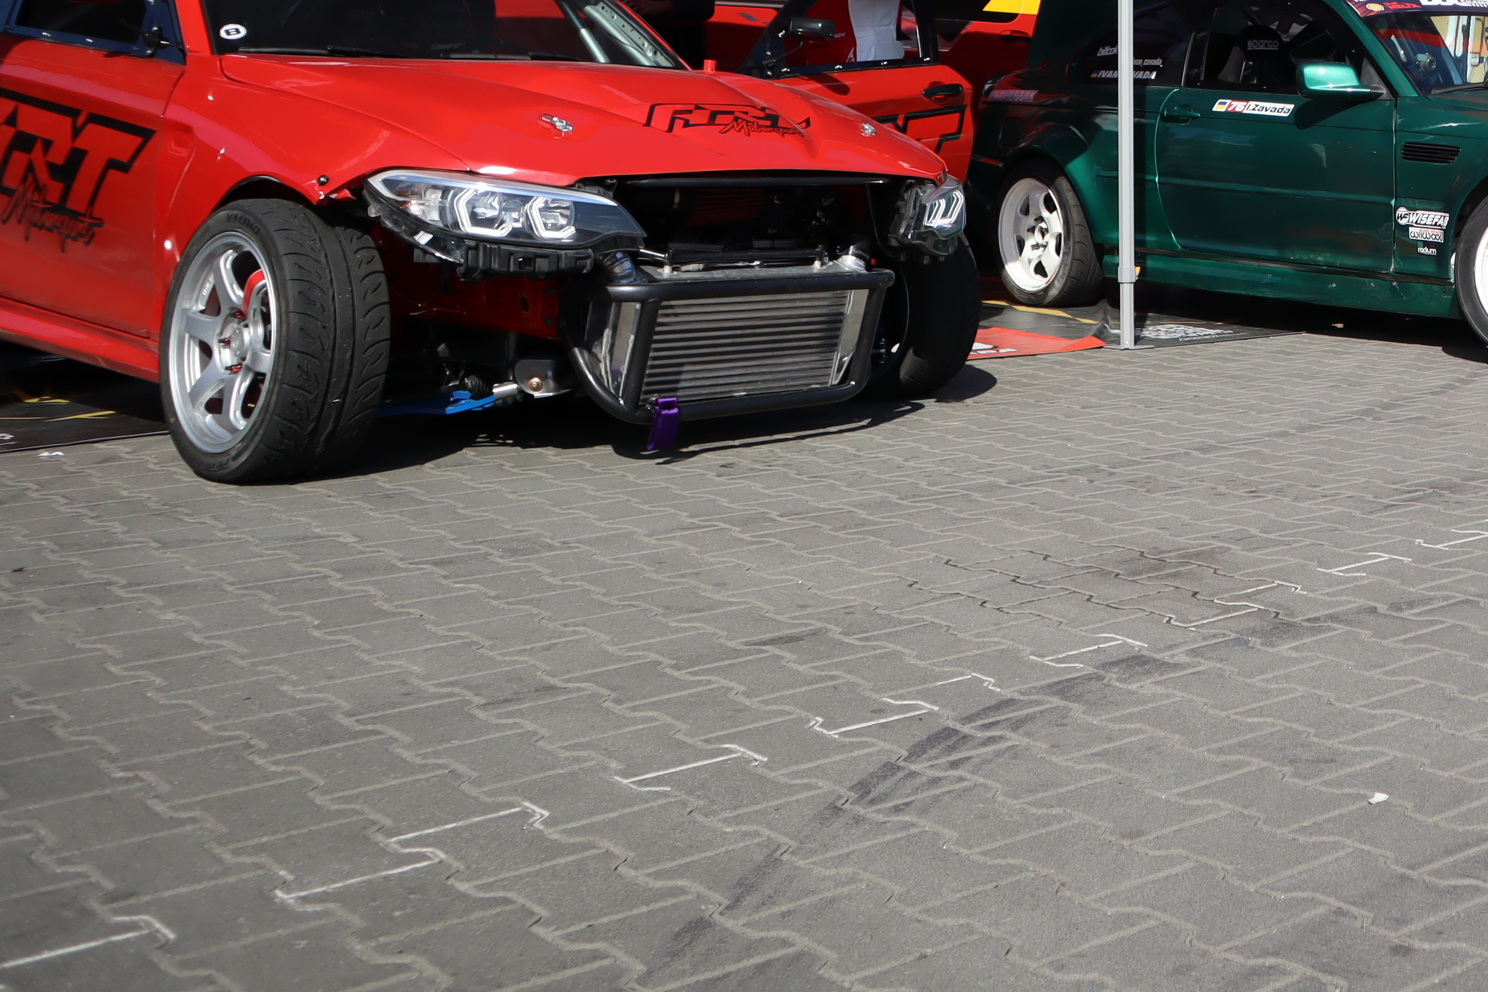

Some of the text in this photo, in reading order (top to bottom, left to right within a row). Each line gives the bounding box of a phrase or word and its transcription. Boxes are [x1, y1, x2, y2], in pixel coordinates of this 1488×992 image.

[1247, 39, 1280, 49] sparco
[1227, 101, 1247, 112] 75
[1408, 212, 1450, 227] WISEFAB
[1417, 246, 1437, 256] radium
